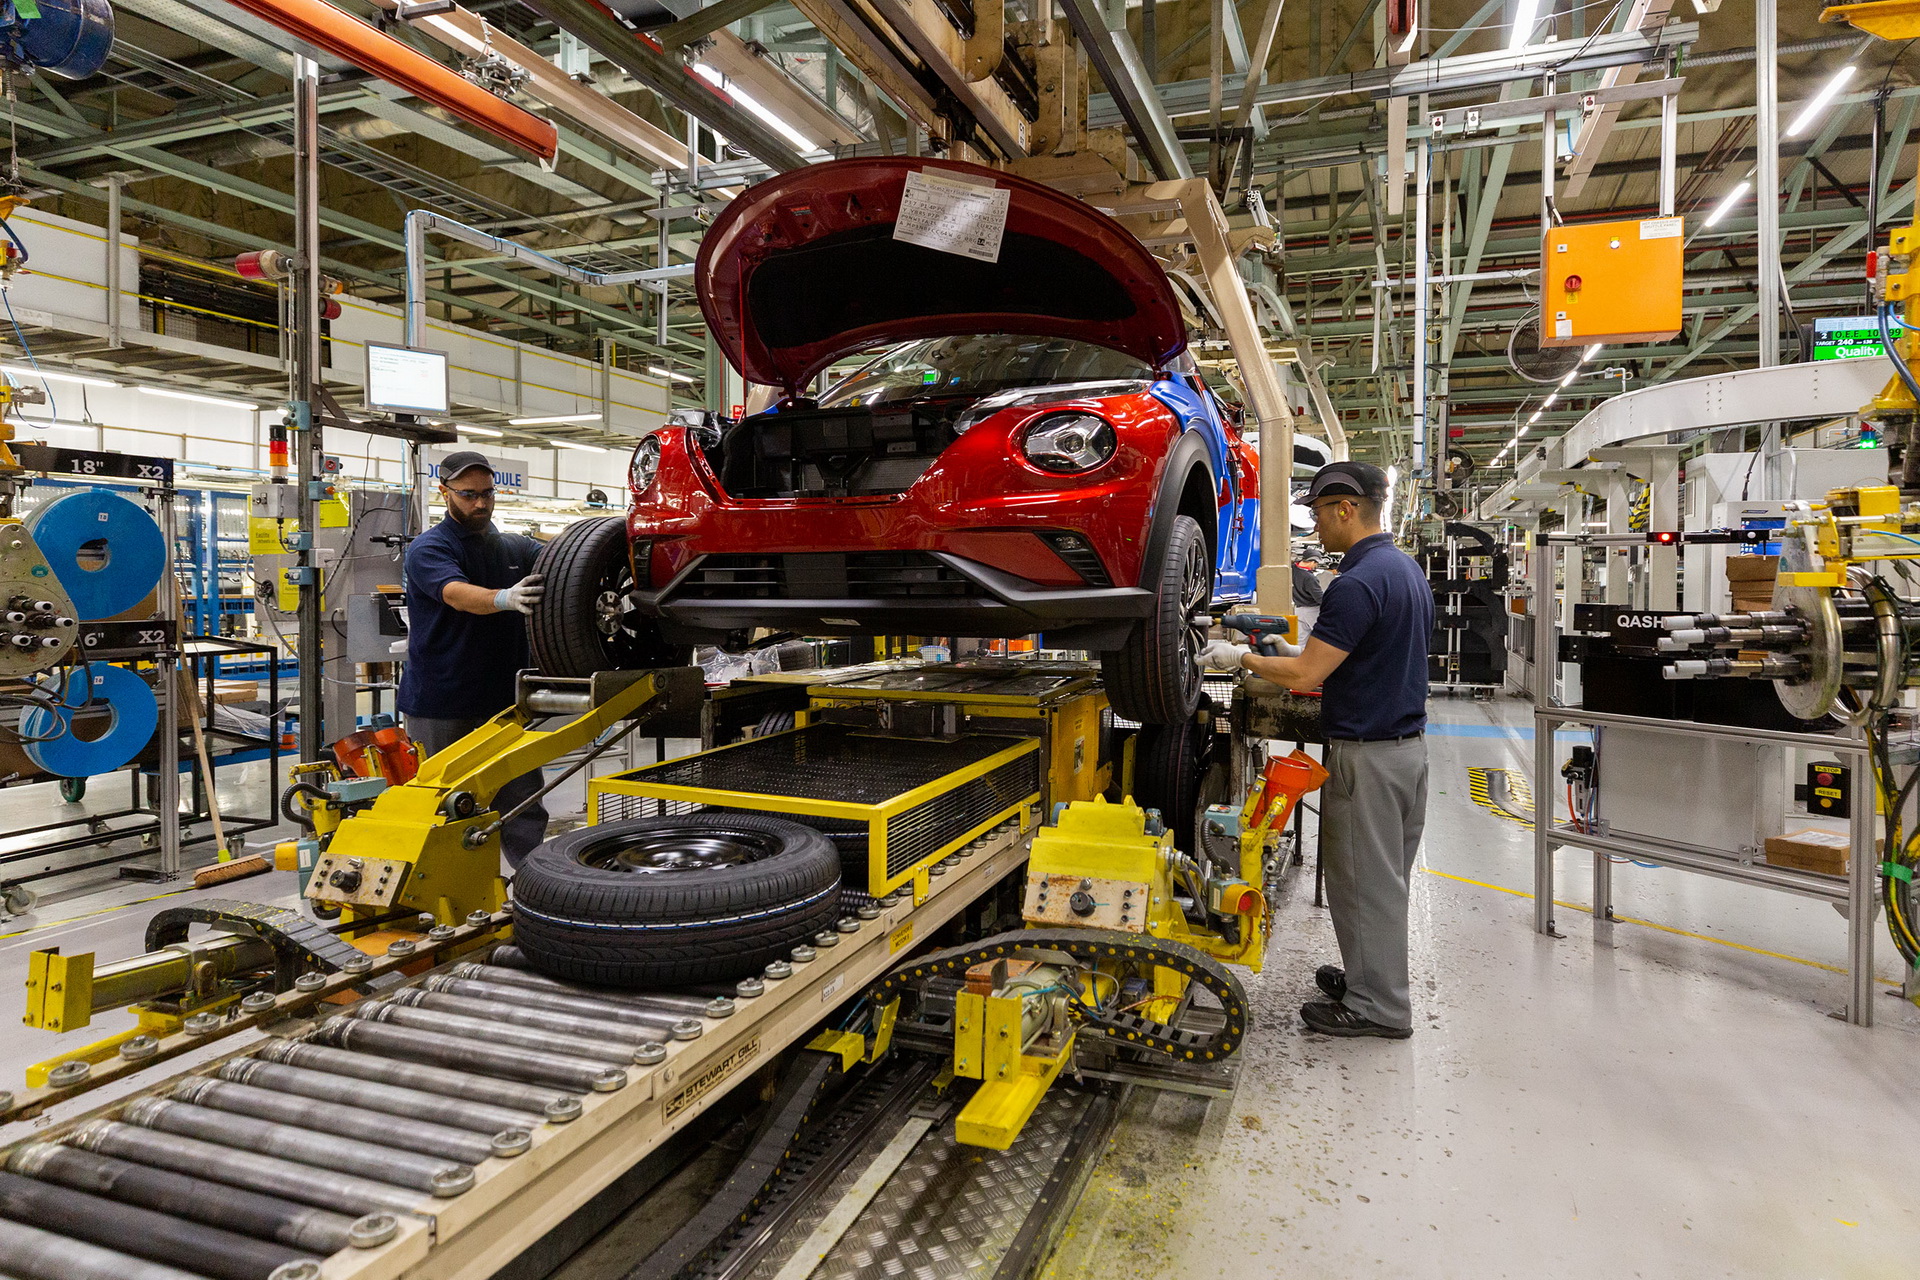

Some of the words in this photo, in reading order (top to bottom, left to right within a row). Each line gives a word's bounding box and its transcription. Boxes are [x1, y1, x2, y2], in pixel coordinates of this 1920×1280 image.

[1835, 346, 1879, 358] Quality
[137, 464, 164, 479] X2
[494, 471, 522, 487] DULE
[1616, 614, 1665, 629] QASH
[138, 630, 165, 644] X2
[686, 1053, 736, 1098] STEWART
[737, 1039, 758, 1059] GILL
